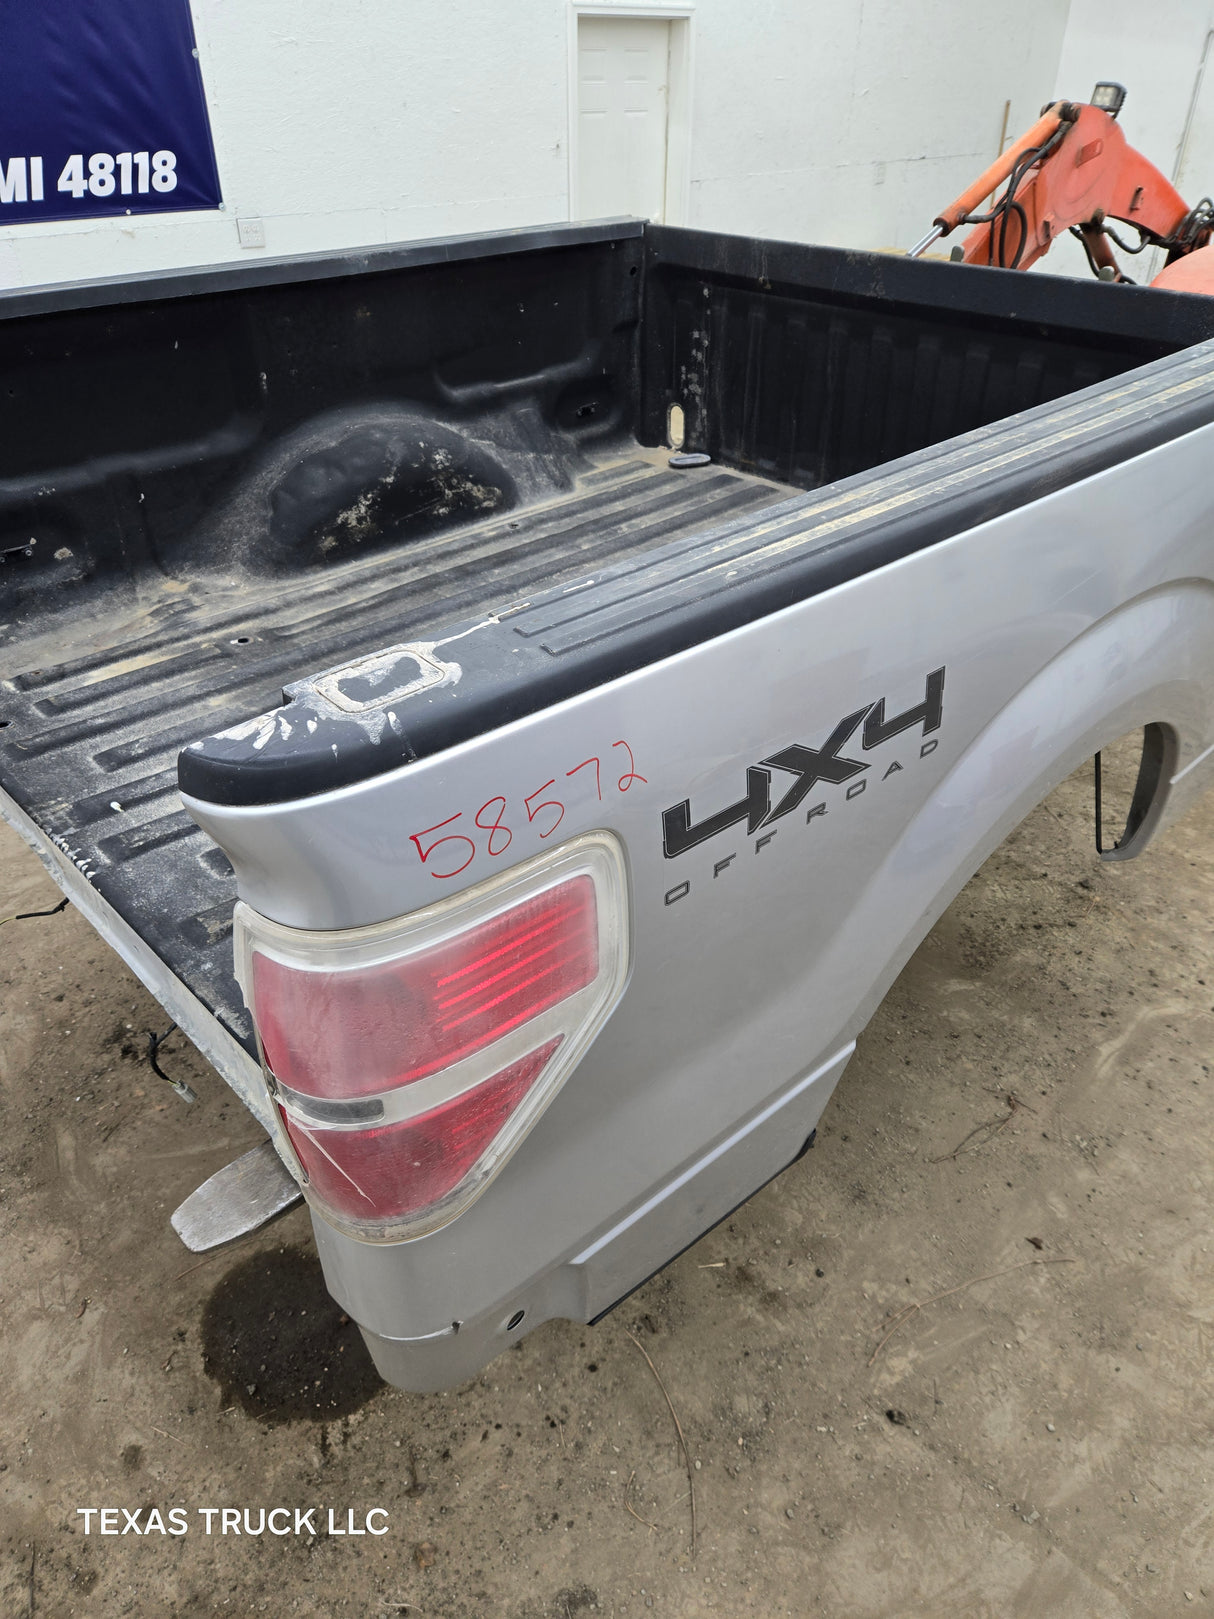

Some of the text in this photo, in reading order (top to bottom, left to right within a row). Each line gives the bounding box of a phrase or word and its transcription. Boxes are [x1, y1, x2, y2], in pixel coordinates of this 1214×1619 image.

[57, 150, 178, 198] 48118
[409, 740, 648, 878] 58572
[661, 665, 946, 859] 4X4
